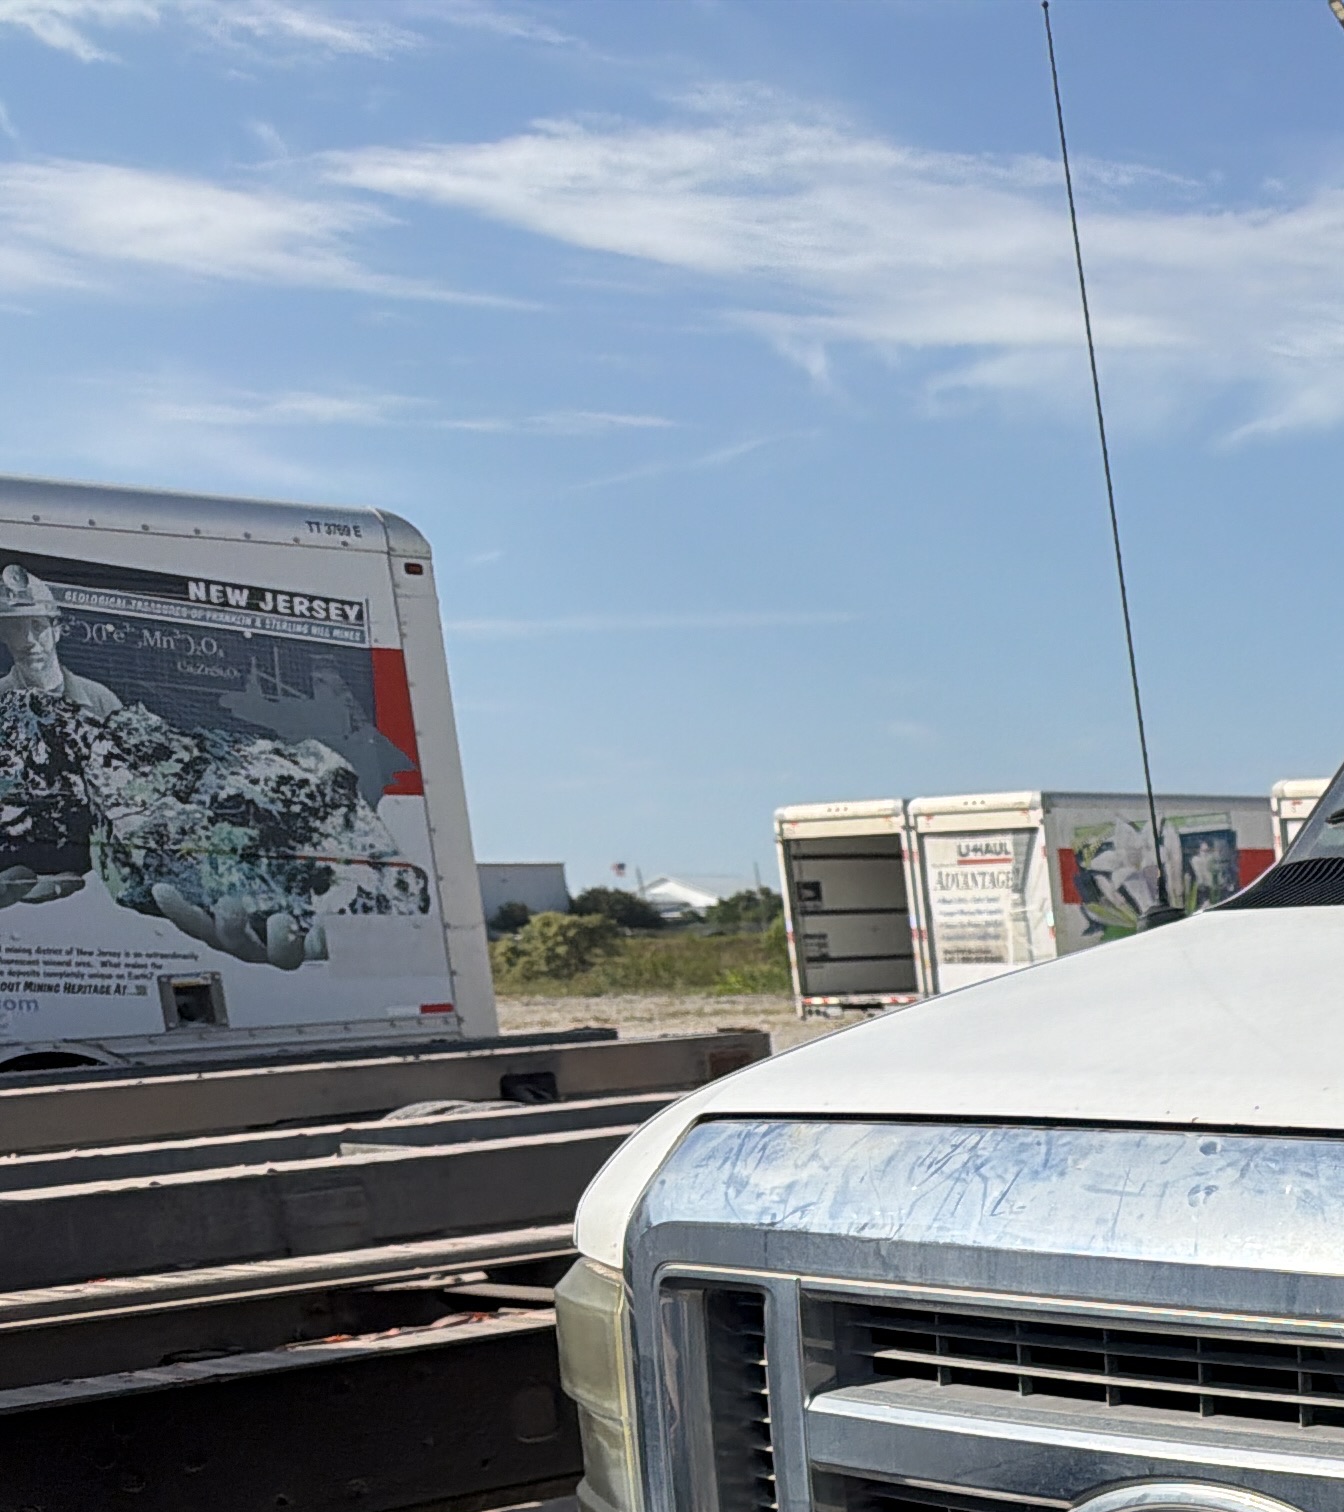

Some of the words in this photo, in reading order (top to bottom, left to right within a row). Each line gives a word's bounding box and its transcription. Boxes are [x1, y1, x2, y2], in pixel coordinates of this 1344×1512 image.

[188, 580, 250, 608] NEW
[258, 591, 361, 624] JERSEY
[957, 841, 1011, 857] U-HAUL
